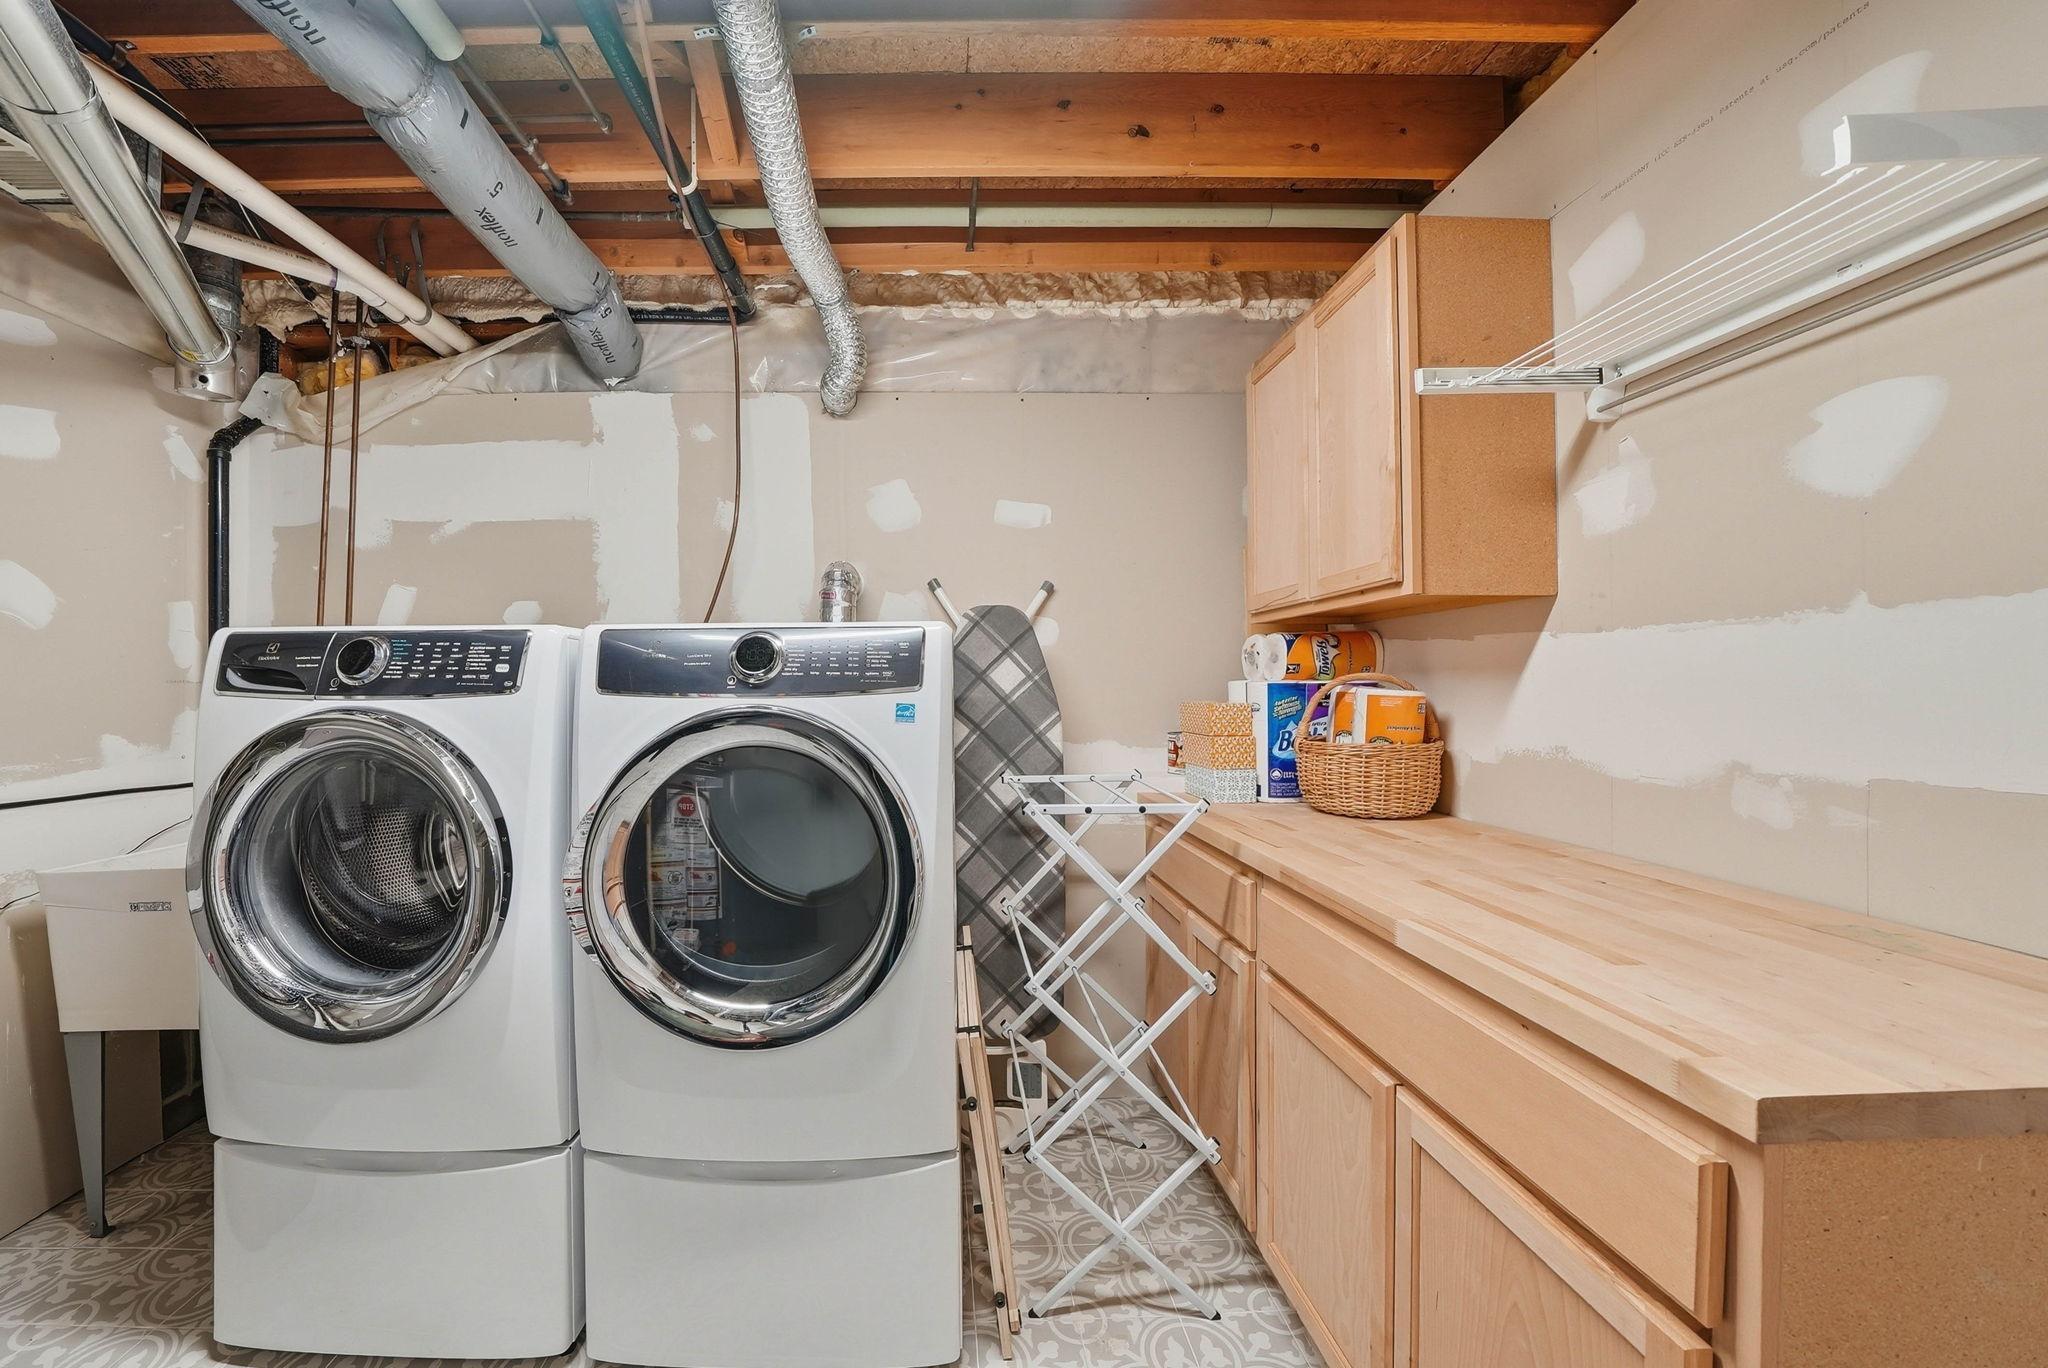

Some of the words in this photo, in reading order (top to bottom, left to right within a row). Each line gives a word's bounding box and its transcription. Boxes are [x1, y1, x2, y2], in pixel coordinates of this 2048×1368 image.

[1776, 1, 1870, 73] usg.com/patents
[473, 206, 519, 248] norflex
[588, 327, 617, 364] norflex
[1317, 639, 1332, 677] Towels
